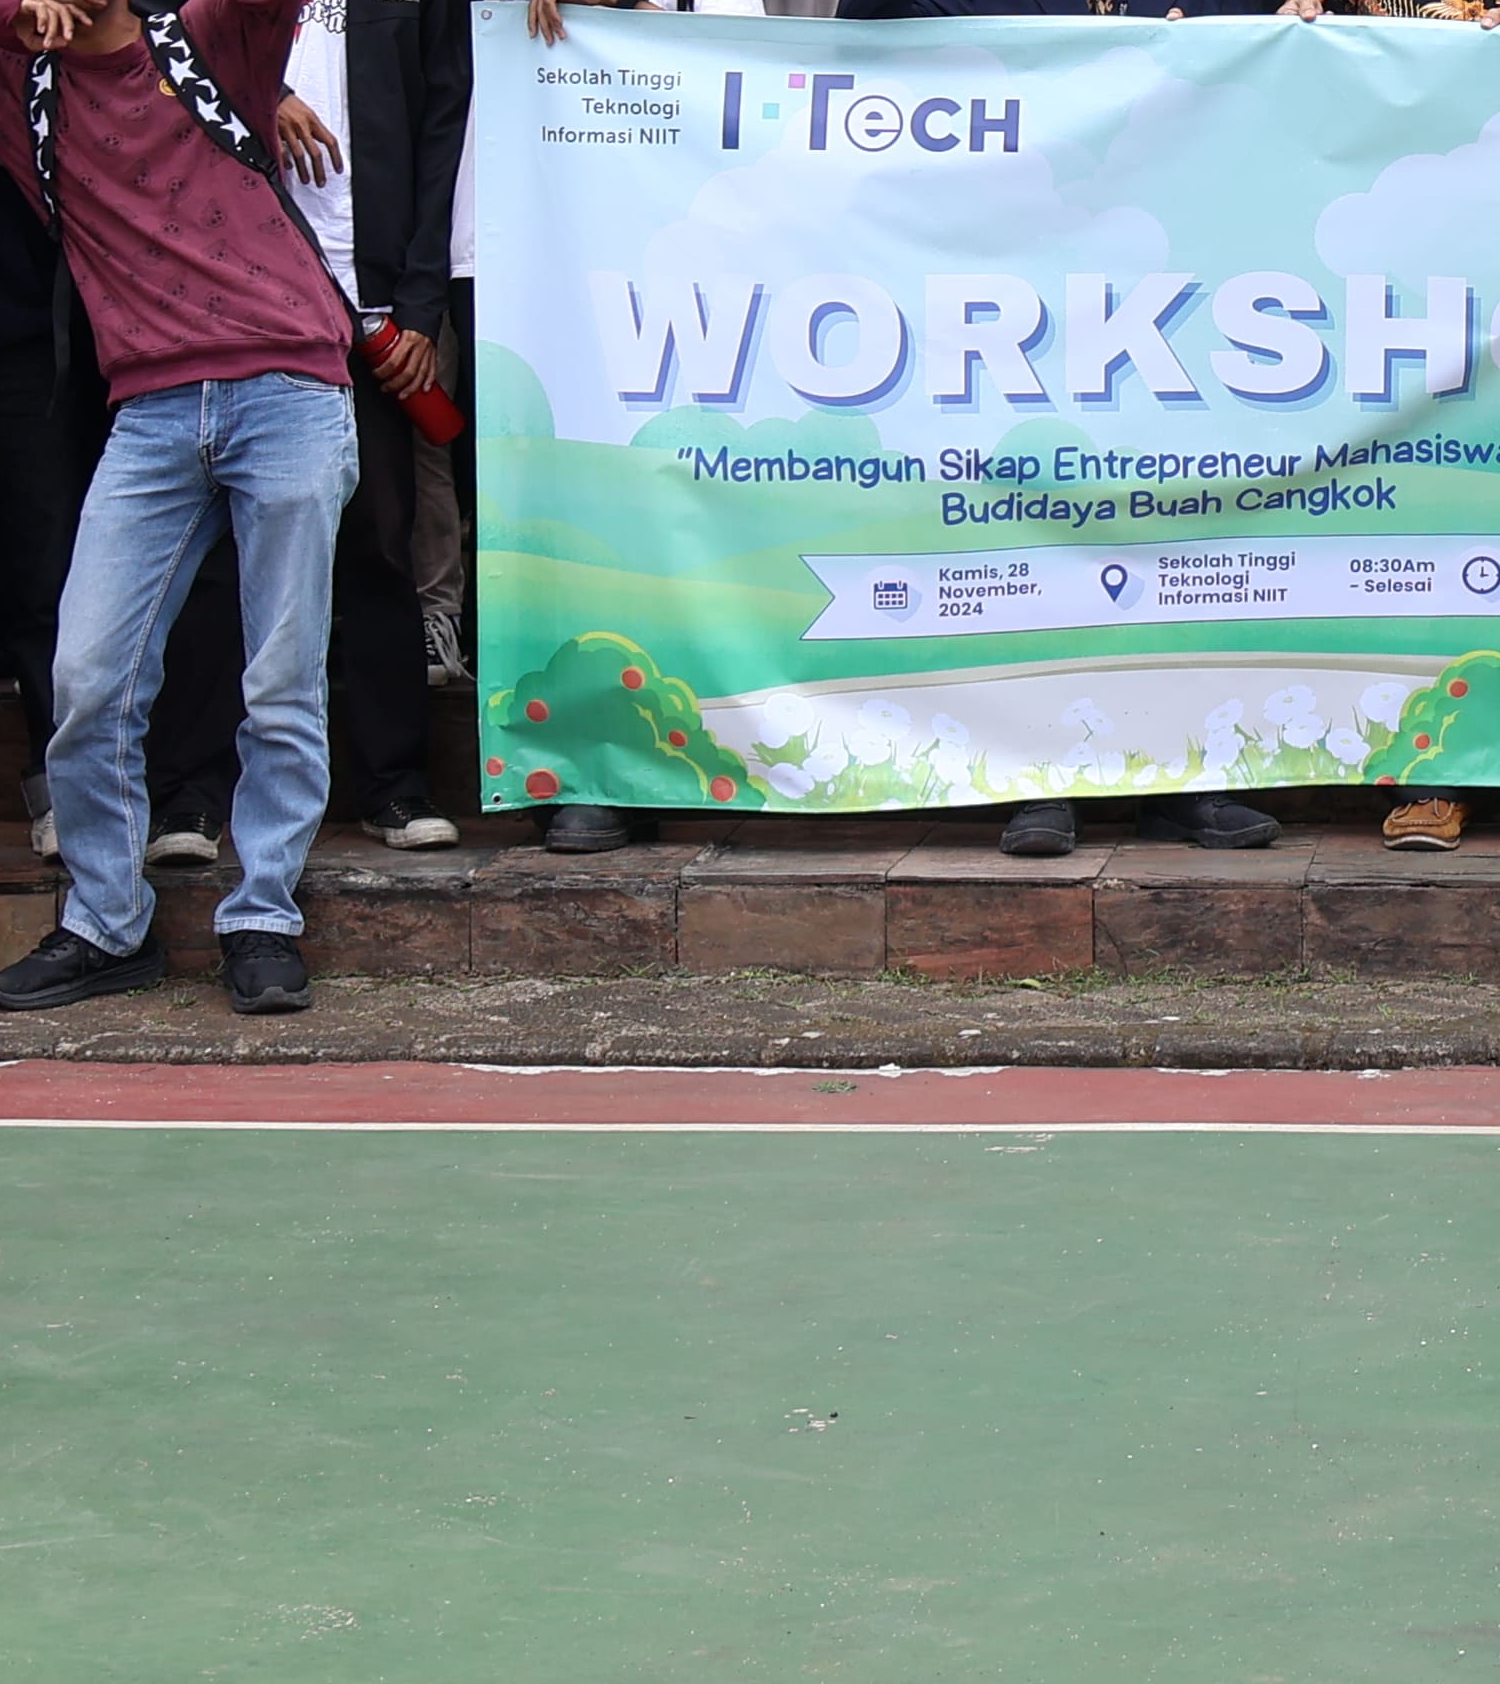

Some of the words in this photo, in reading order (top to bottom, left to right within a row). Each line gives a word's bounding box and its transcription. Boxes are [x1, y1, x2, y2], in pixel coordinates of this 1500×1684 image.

[536, 66, 612, 86] Sekolah
[617, 68, 682, 92] Tinggi
[581, 97, 681, 121] Teknologi
[541, 125, 633, 145] Informasi
[639, 127, 681, 145] NIIT
[939, 447, 1041, 485] Sikap
[1052, 446, 1302, 485] Entrepreneur
[941, 491, 1117, 529] Budidaya
[1129, 489, 1223, 519] Buah
[1235, 476, 1397, 517] Cangkok
[1158, 553, 1234, 570] Sekolah
[1237, 551, 1297, 572] Tinggi
[1350, 558, 1436, 574] 08:30Am
[938, 564, 1004, 583] Kamis,
[1007, 562, 1030, 578] 28
[1158, 570, 1251, 590] Teknologi
[938, 581, 1043, 600] November,
[1364, 577, 1433, 594] Selesai
[1158, 587, 1249, 605] Informasi
[1253, 587, 1289, 604] NIIT
[938, 601, 984, 617] 2024
